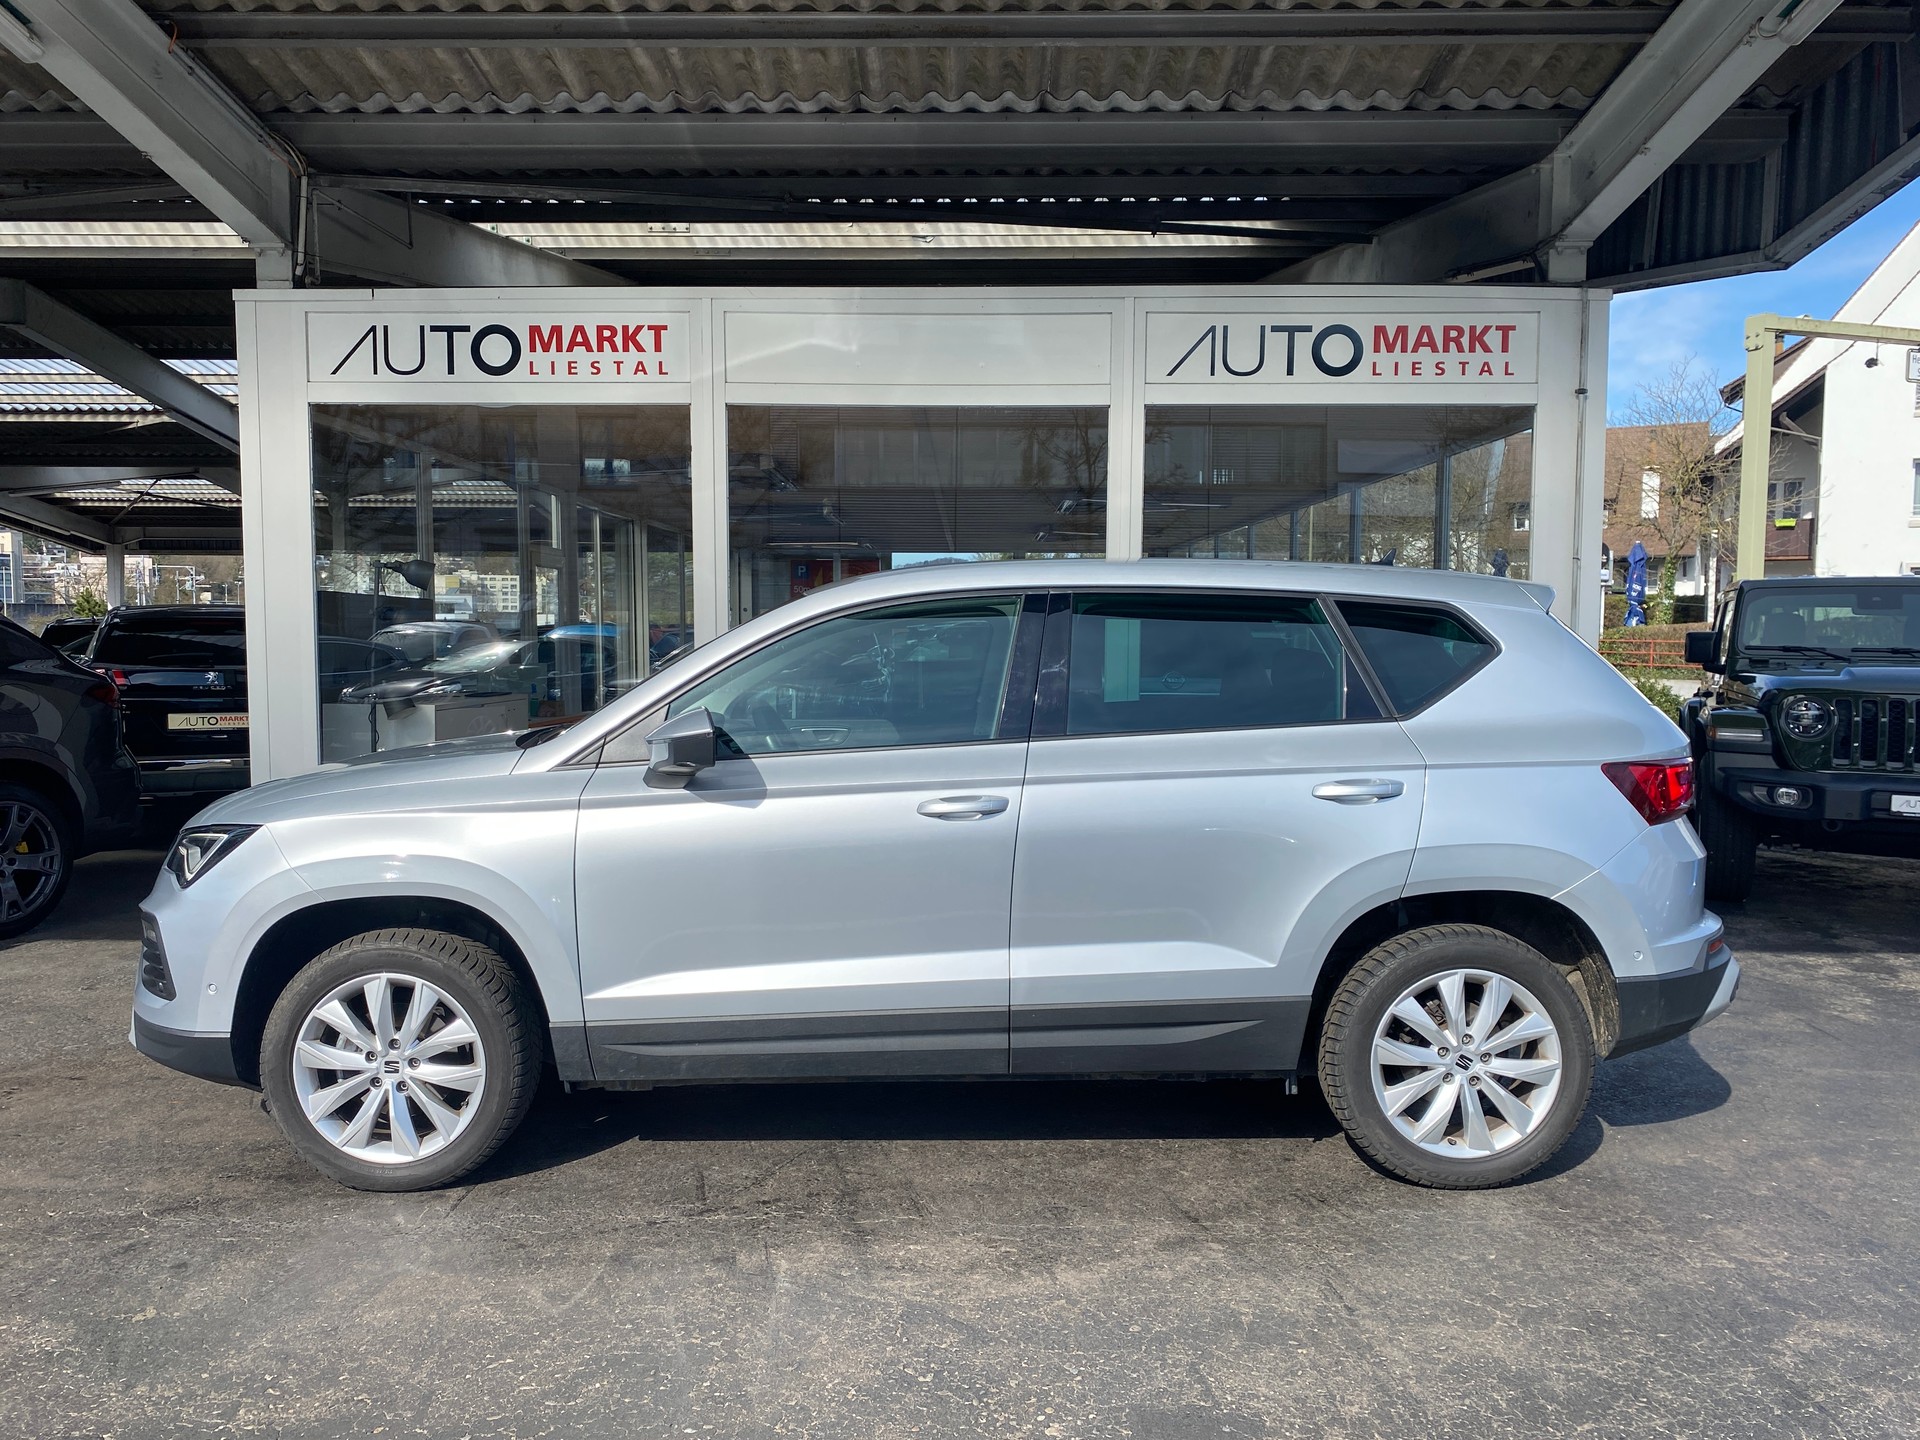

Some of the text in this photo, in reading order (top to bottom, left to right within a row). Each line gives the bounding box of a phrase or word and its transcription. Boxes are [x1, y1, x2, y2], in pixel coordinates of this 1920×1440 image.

[330, 324, 668, 376] AUTO MARKT
[1166, 324, 1517, 377] AUTO MARKT
[529, 361, 669, 375] LIESTAL
[1372, 361, 1515, 376] LIESTAL
[178, 716, 219, 726] AUTO
